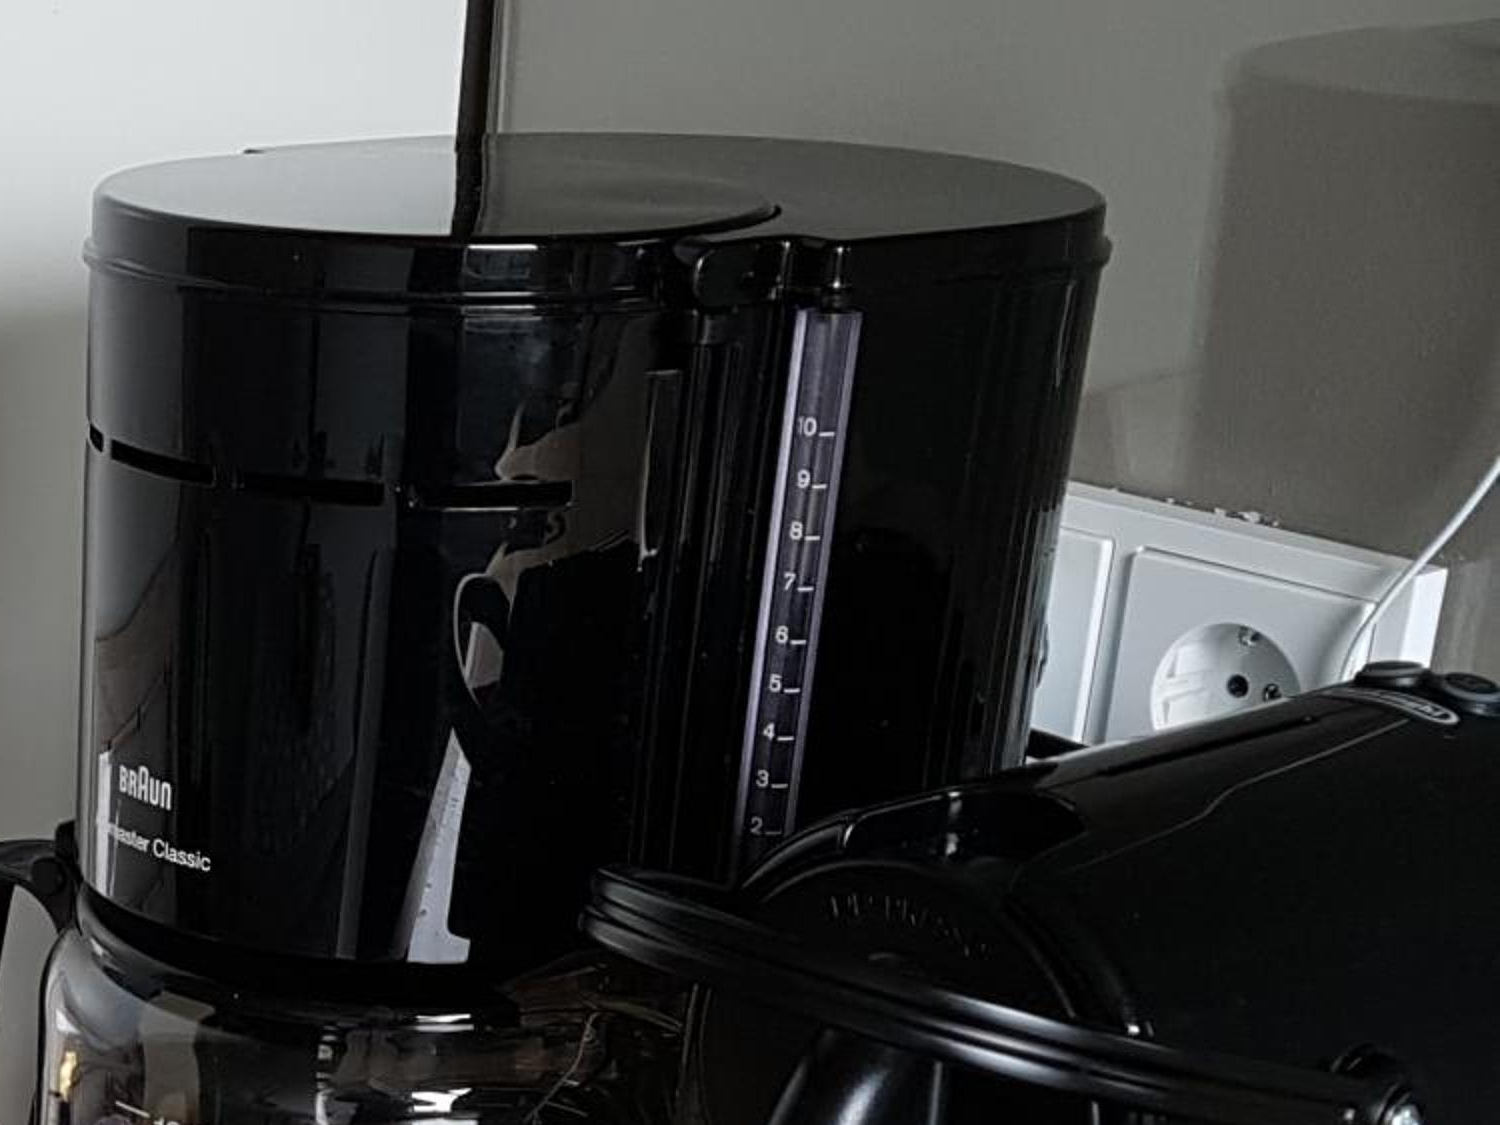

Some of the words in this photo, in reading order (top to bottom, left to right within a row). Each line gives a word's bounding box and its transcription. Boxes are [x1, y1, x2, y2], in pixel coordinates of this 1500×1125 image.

[797, 416, 817, 437] 10
[797, 468, 811, 488] 9
[789, 520, 803, 540] 8
[784, 571, 796, 591] 7
[775, 625, 789, 644] 6
[769, 673, 782, 693] 5
[763, 722, 775, 741] 4
[119, 765, 171, 811] BRAUN
[756, 769, 769, 788] 3
[750, 816, 763, 835] 2
[153, 839, 211, 872] Classic
